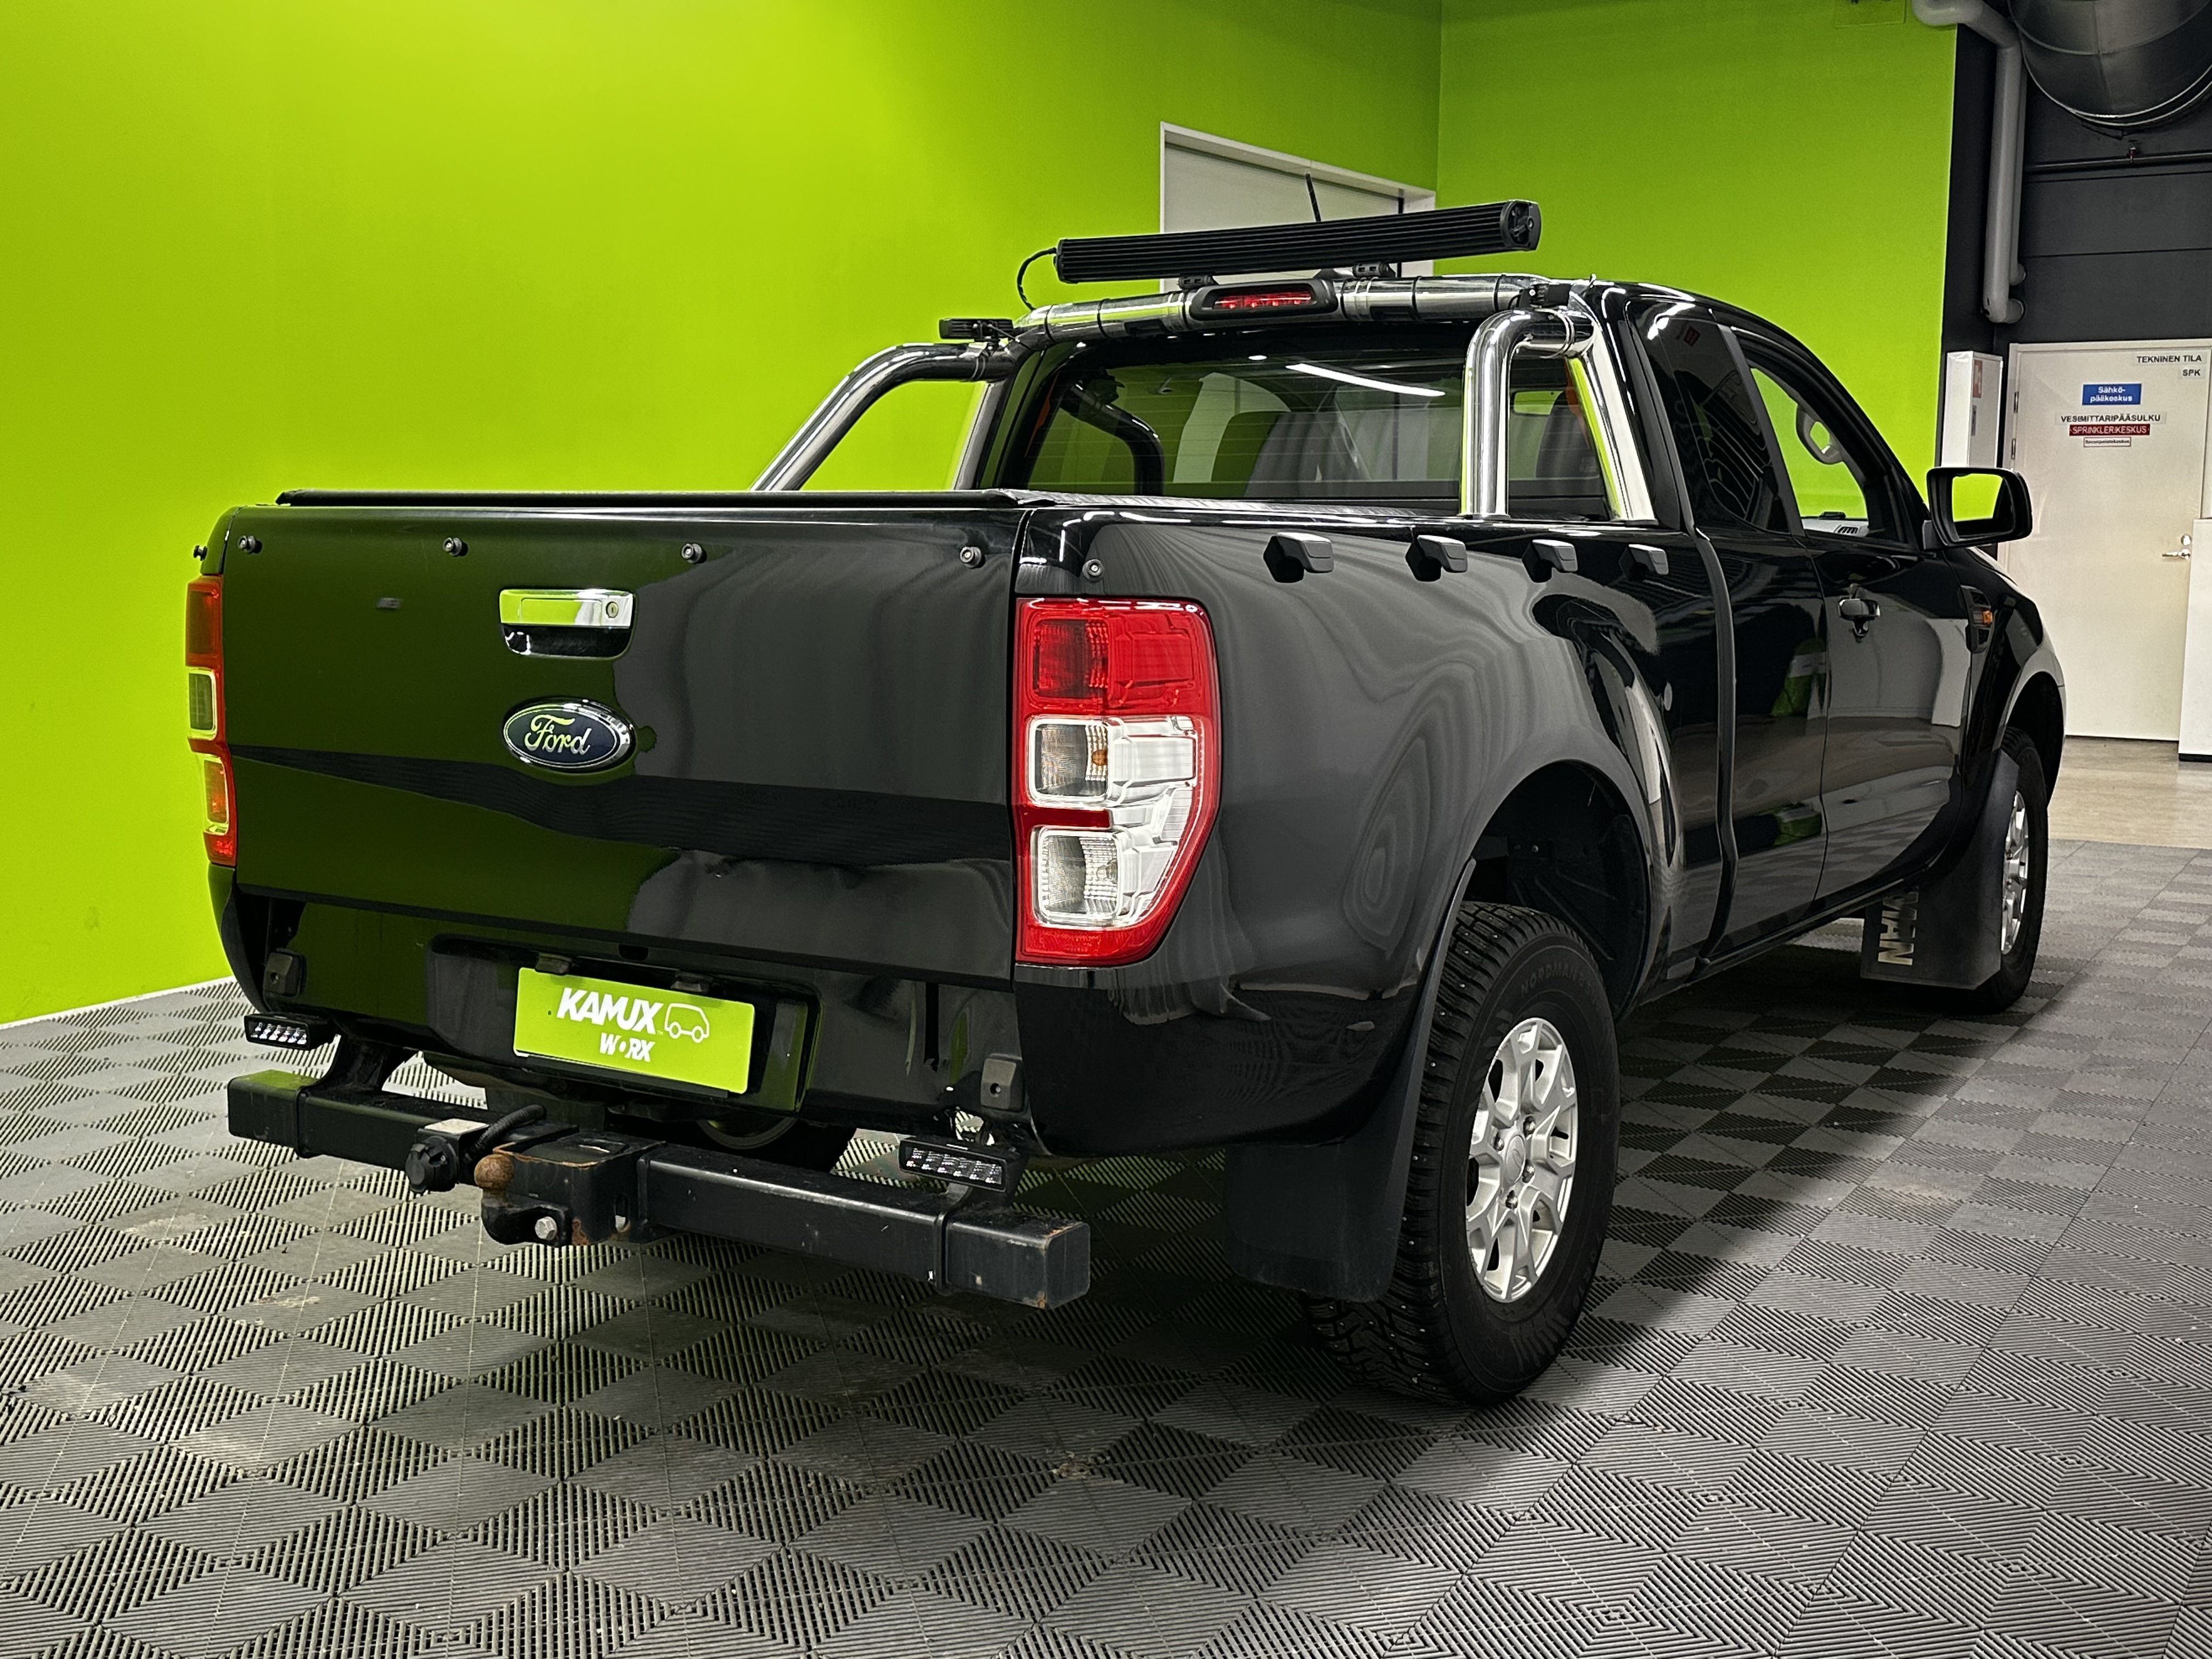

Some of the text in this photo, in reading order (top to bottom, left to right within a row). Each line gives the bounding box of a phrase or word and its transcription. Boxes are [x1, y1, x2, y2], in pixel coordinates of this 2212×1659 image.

[2136, 354, 2181, 363] TEKNINEN
[2090, 394, 2133, 403] pääkeskus
[2061, 413, 2161, 422] VESIMITTARIPÄÄSULKU
[2072, 426, 2147, 434] SPRINKLERIKESKUS
[524, 714, 592, 755] Ford
[556, 987, 664, 1035] KAMUX
